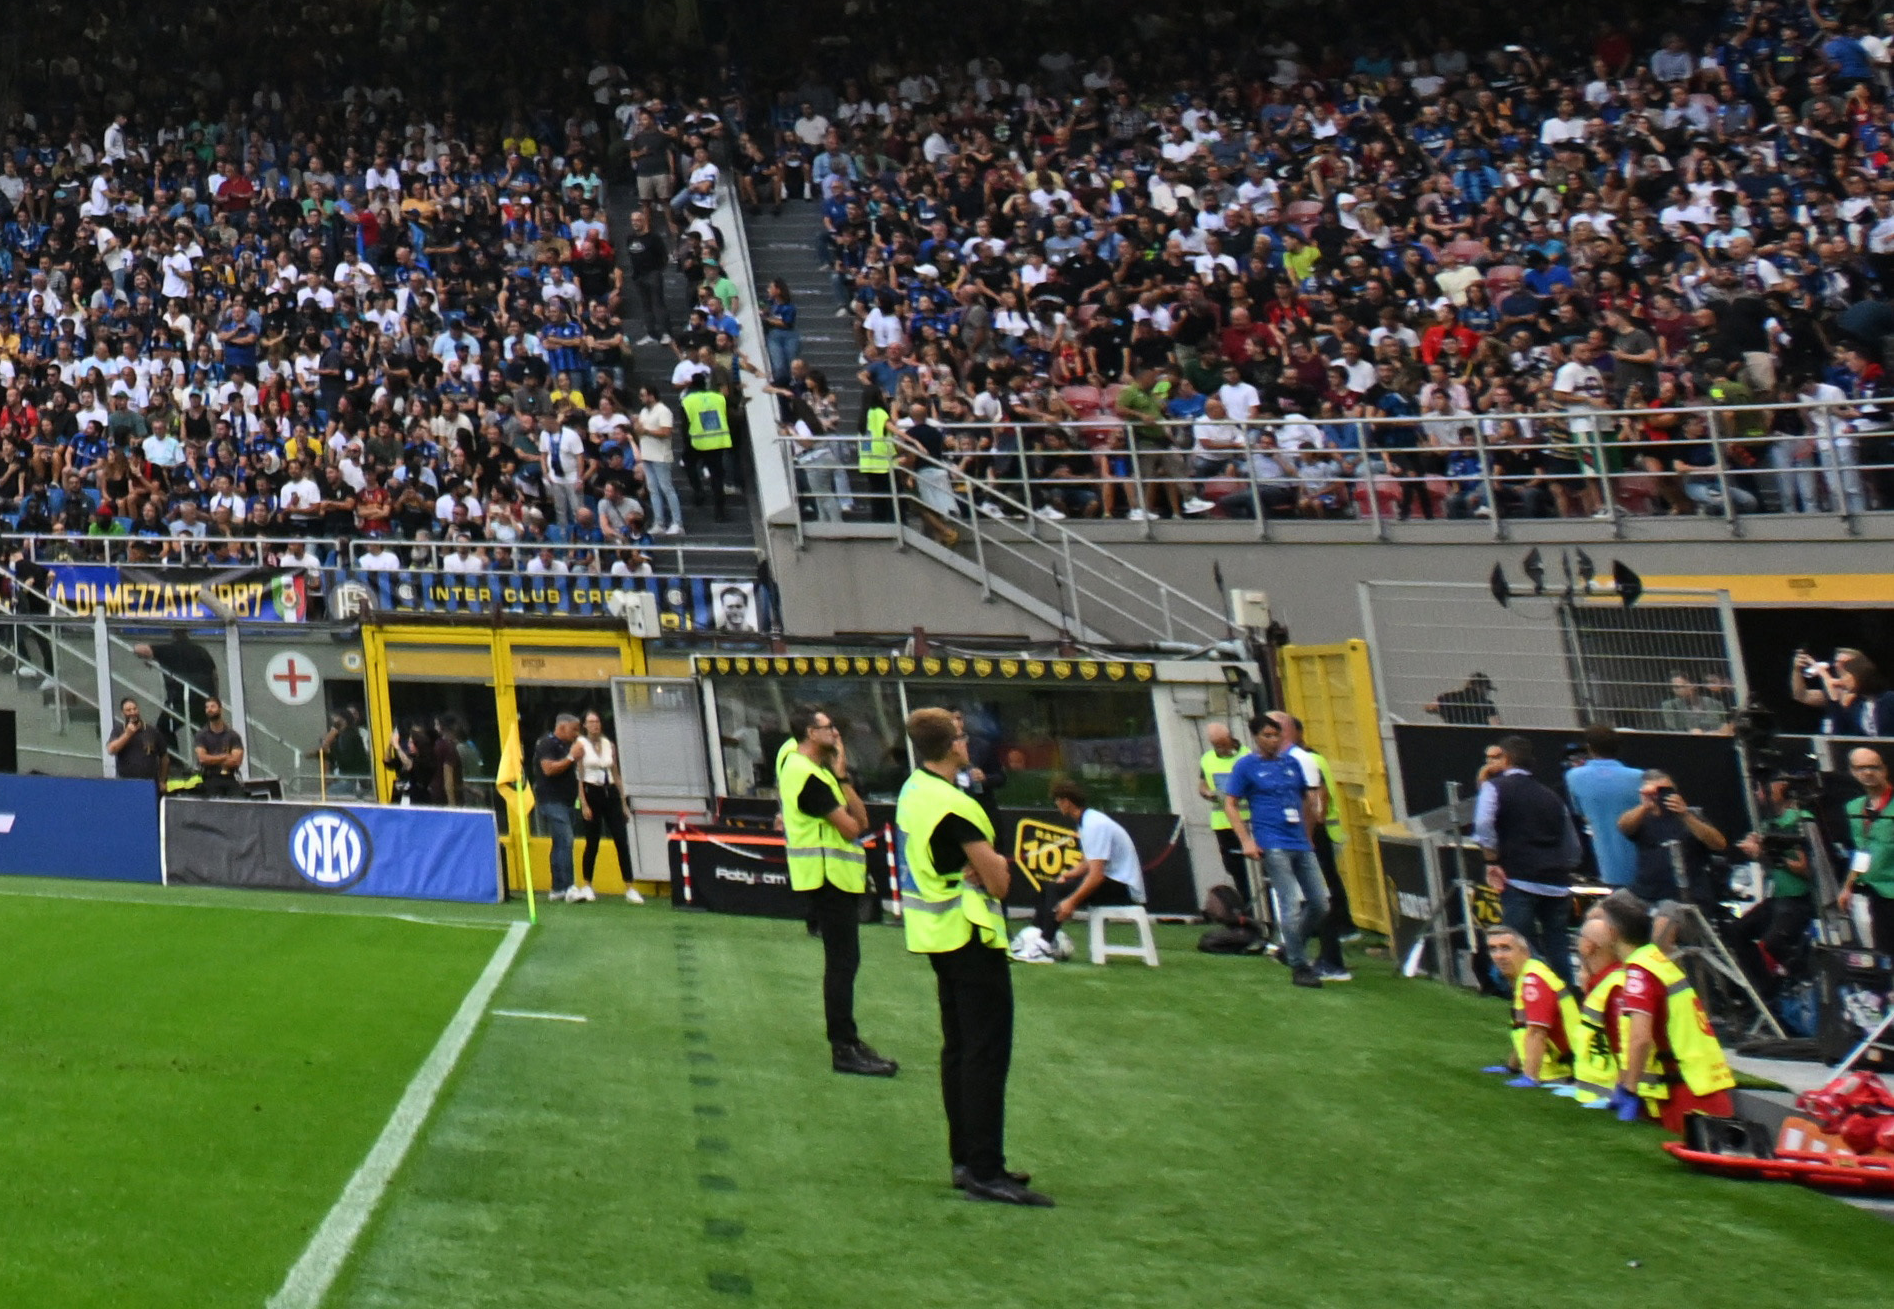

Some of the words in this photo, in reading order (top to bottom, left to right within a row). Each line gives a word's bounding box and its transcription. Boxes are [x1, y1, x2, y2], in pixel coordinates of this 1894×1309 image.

[104, 582, 204, 618] MEZZATE
[429, 586, 491, 603] INTER
[503, 587, 561, 604] CLUB
